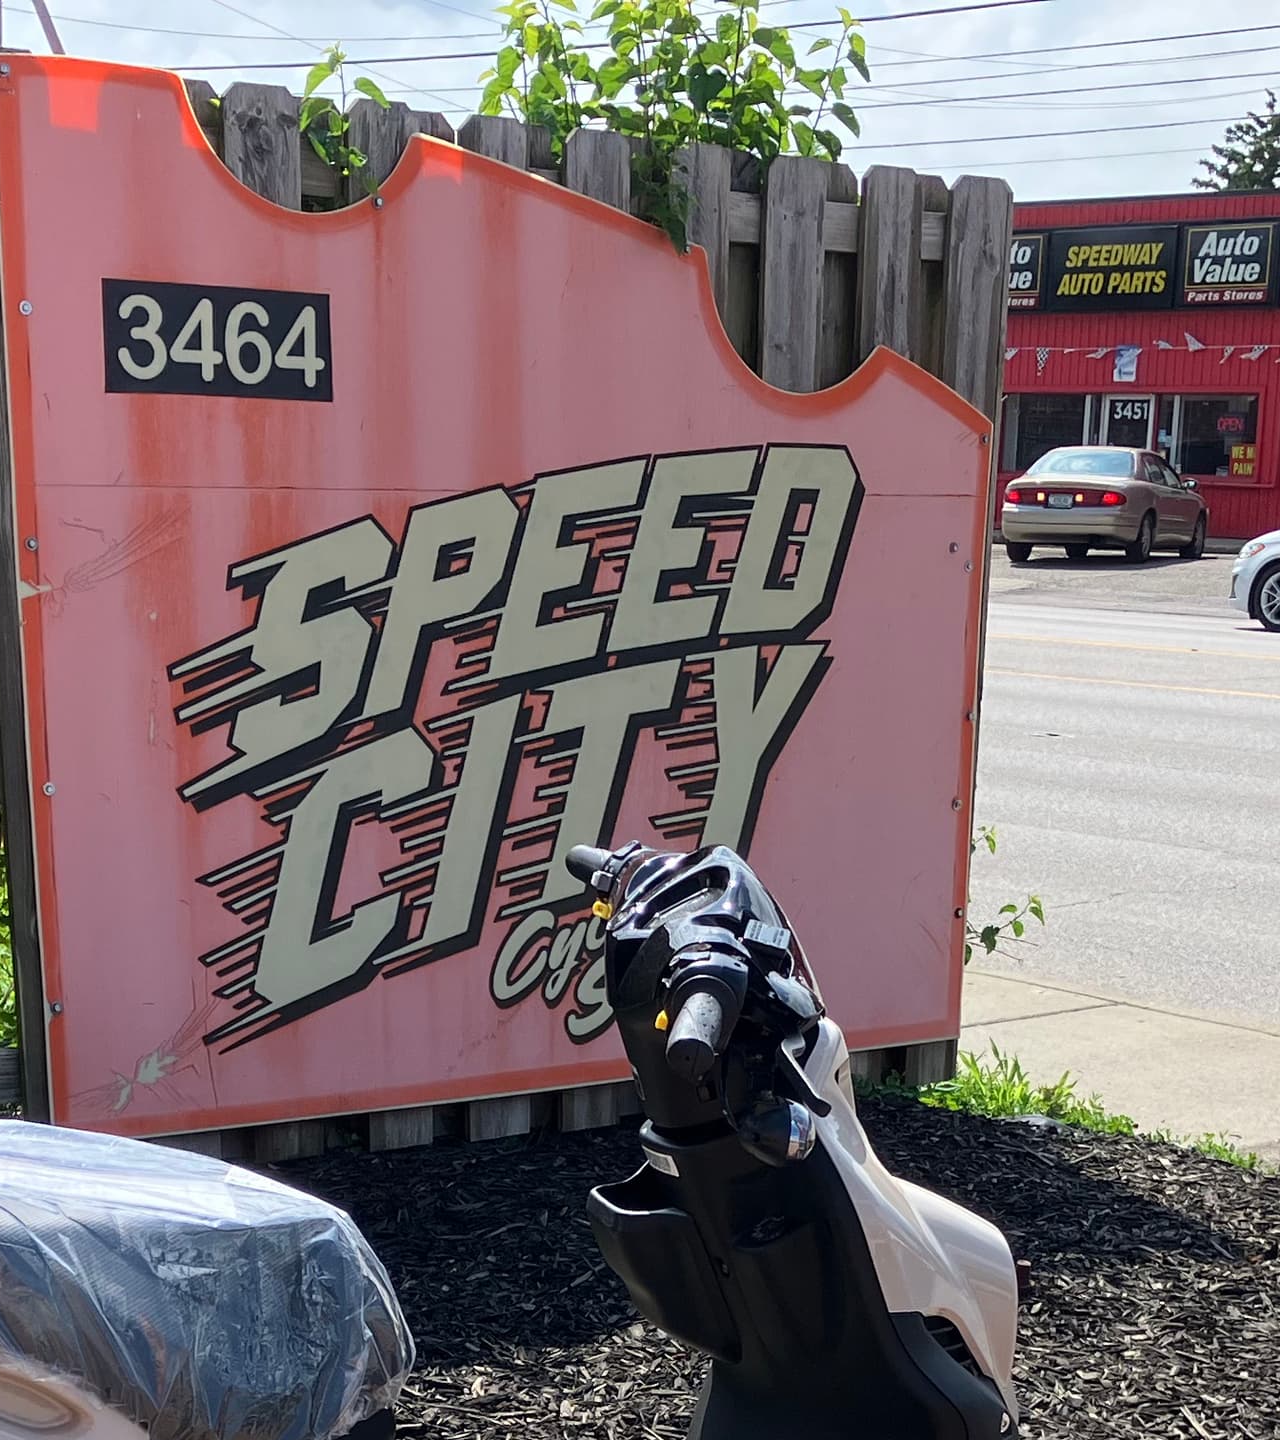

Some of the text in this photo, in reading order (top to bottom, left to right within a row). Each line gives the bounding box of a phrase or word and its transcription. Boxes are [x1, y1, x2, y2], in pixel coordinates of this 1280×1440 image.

[1065, 243, 1164, 268] SPEEDWAY
[1198, 230, 1260, 257] Auto
[1193, 257, 1261, 283] Value
[1056, 271, 1167, 296] AUTO PARTS
[1187, 290, 1264, 302] Parts Stores
[117, 293, 325, 389] 3464
[1114, 402, 1149, 420] 3451
[180, 443, 865, 785] SPEED
[205, 638, 832, 1032] CITY
